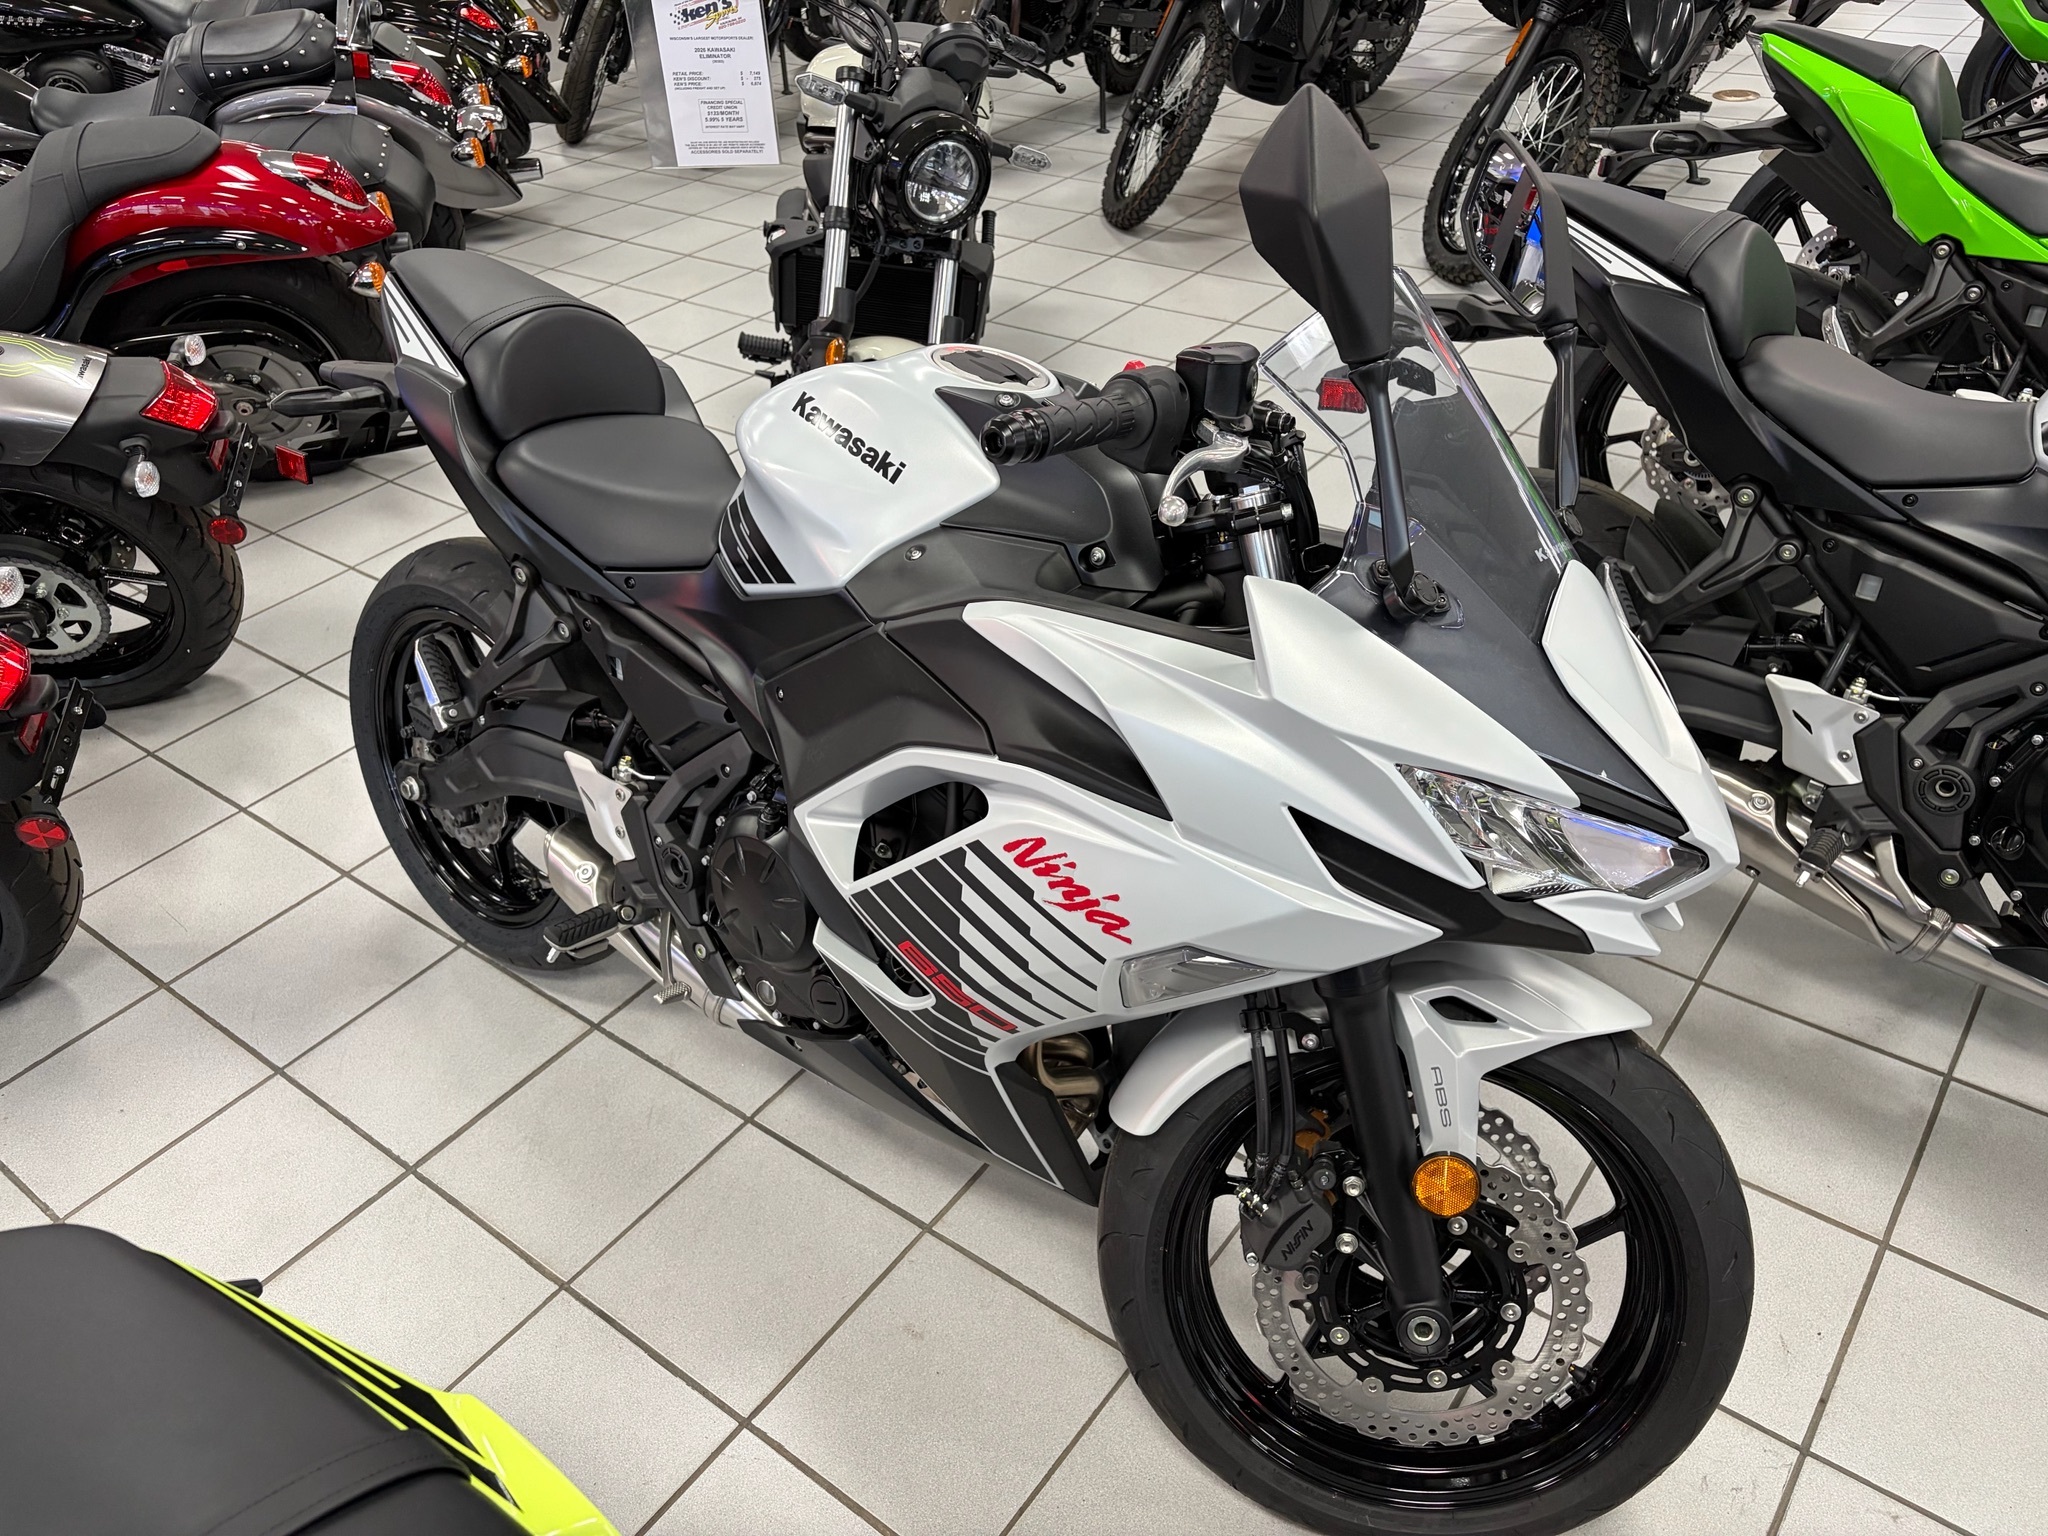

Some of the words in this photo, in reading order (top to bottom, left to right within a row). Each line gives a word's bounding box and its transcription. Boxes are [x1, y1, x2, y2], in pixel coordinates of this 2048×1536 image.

[791, 391, 907, 485] Kawasaki
[1003, 837, 1132, 945] Ninja
[898, 940, 1018, 1031] 650
[1430, 1066, 1452, 1128] ABS
